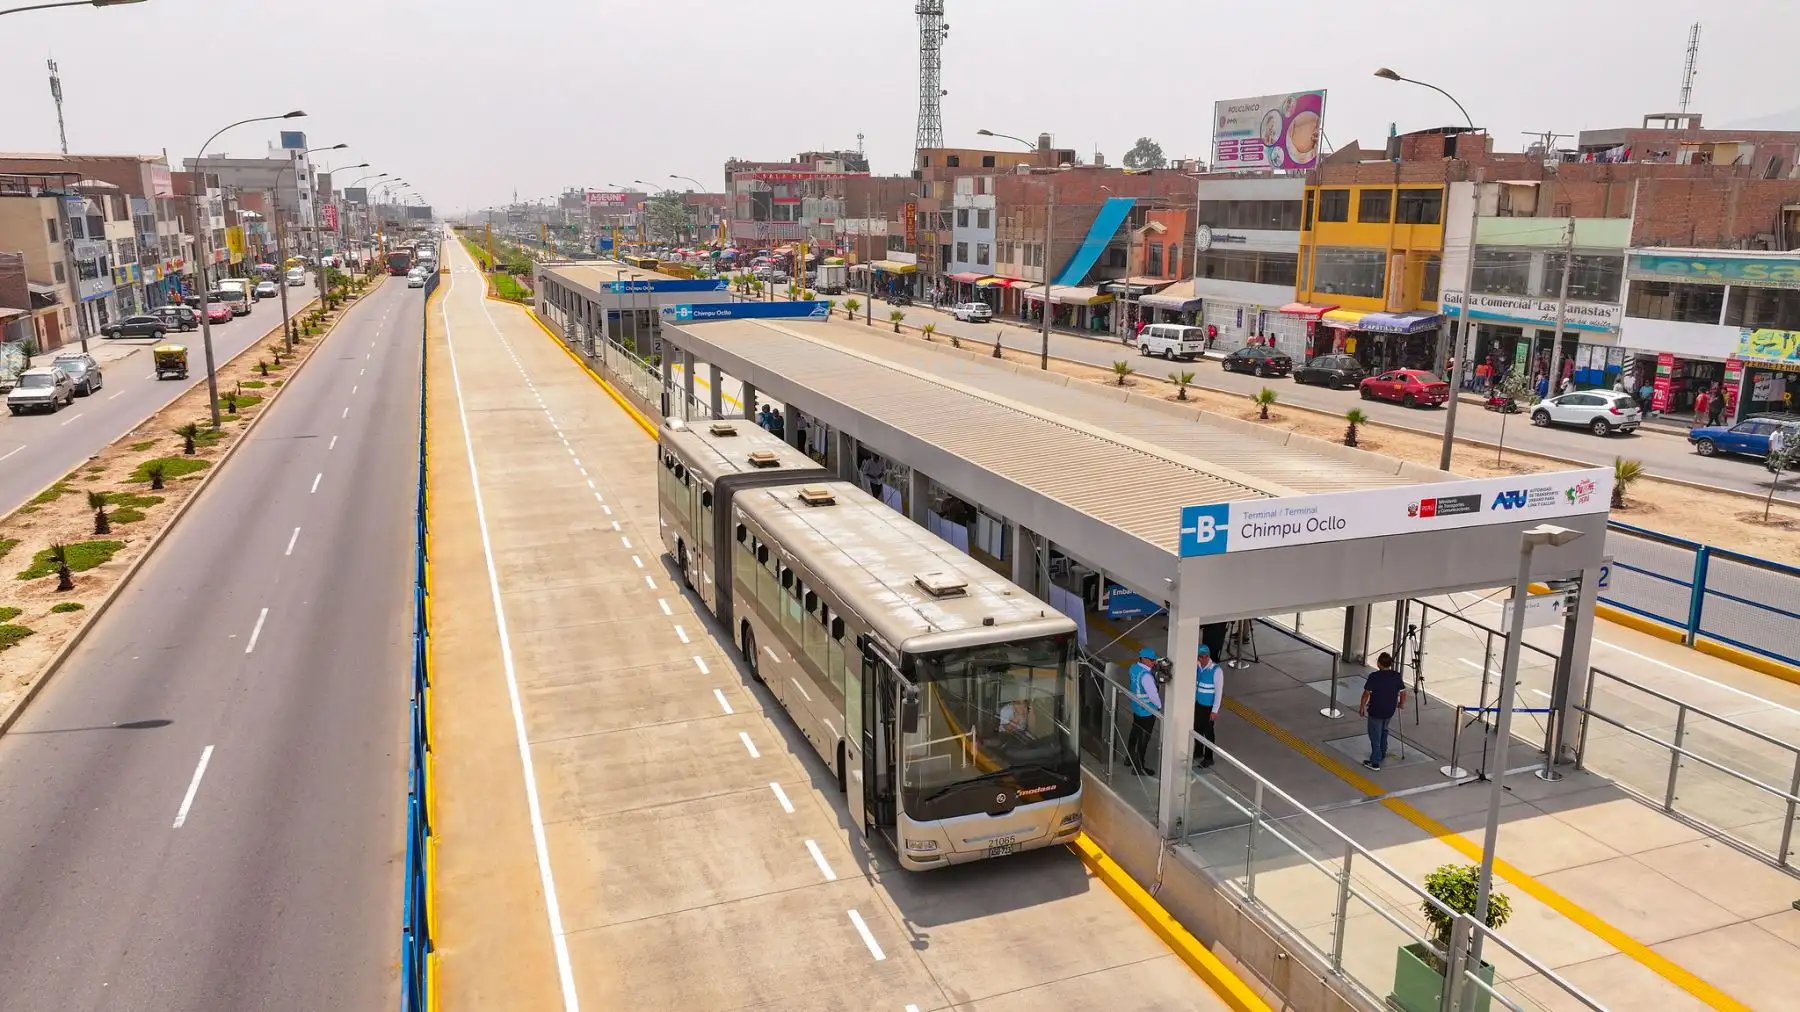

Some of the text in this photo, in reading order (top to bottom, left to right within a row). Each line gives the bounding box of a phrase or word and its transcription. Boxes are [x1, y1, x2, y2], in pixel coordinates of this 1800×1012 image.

[1444, 293, 1478, 305] Galeia
[1480, 296, 1532, 310] Comercial
[680, 308, 688, 317] B
[1421, 503, 1436, 512] PERÚ
[1491, 489, 1528, 511] ATU
[1243, 510, 1277, 520] Terminal
[1284, 506, 1318, 517] Terminal
[1197, 515, 1216, 543] B
[1241, 516, 1346, 539] Chimpu Ocllo
[1598, 566, 1609, 587] 2
[1019, 785, 1057, 796] modasa
[988, 835, 1016, 847] 21065
